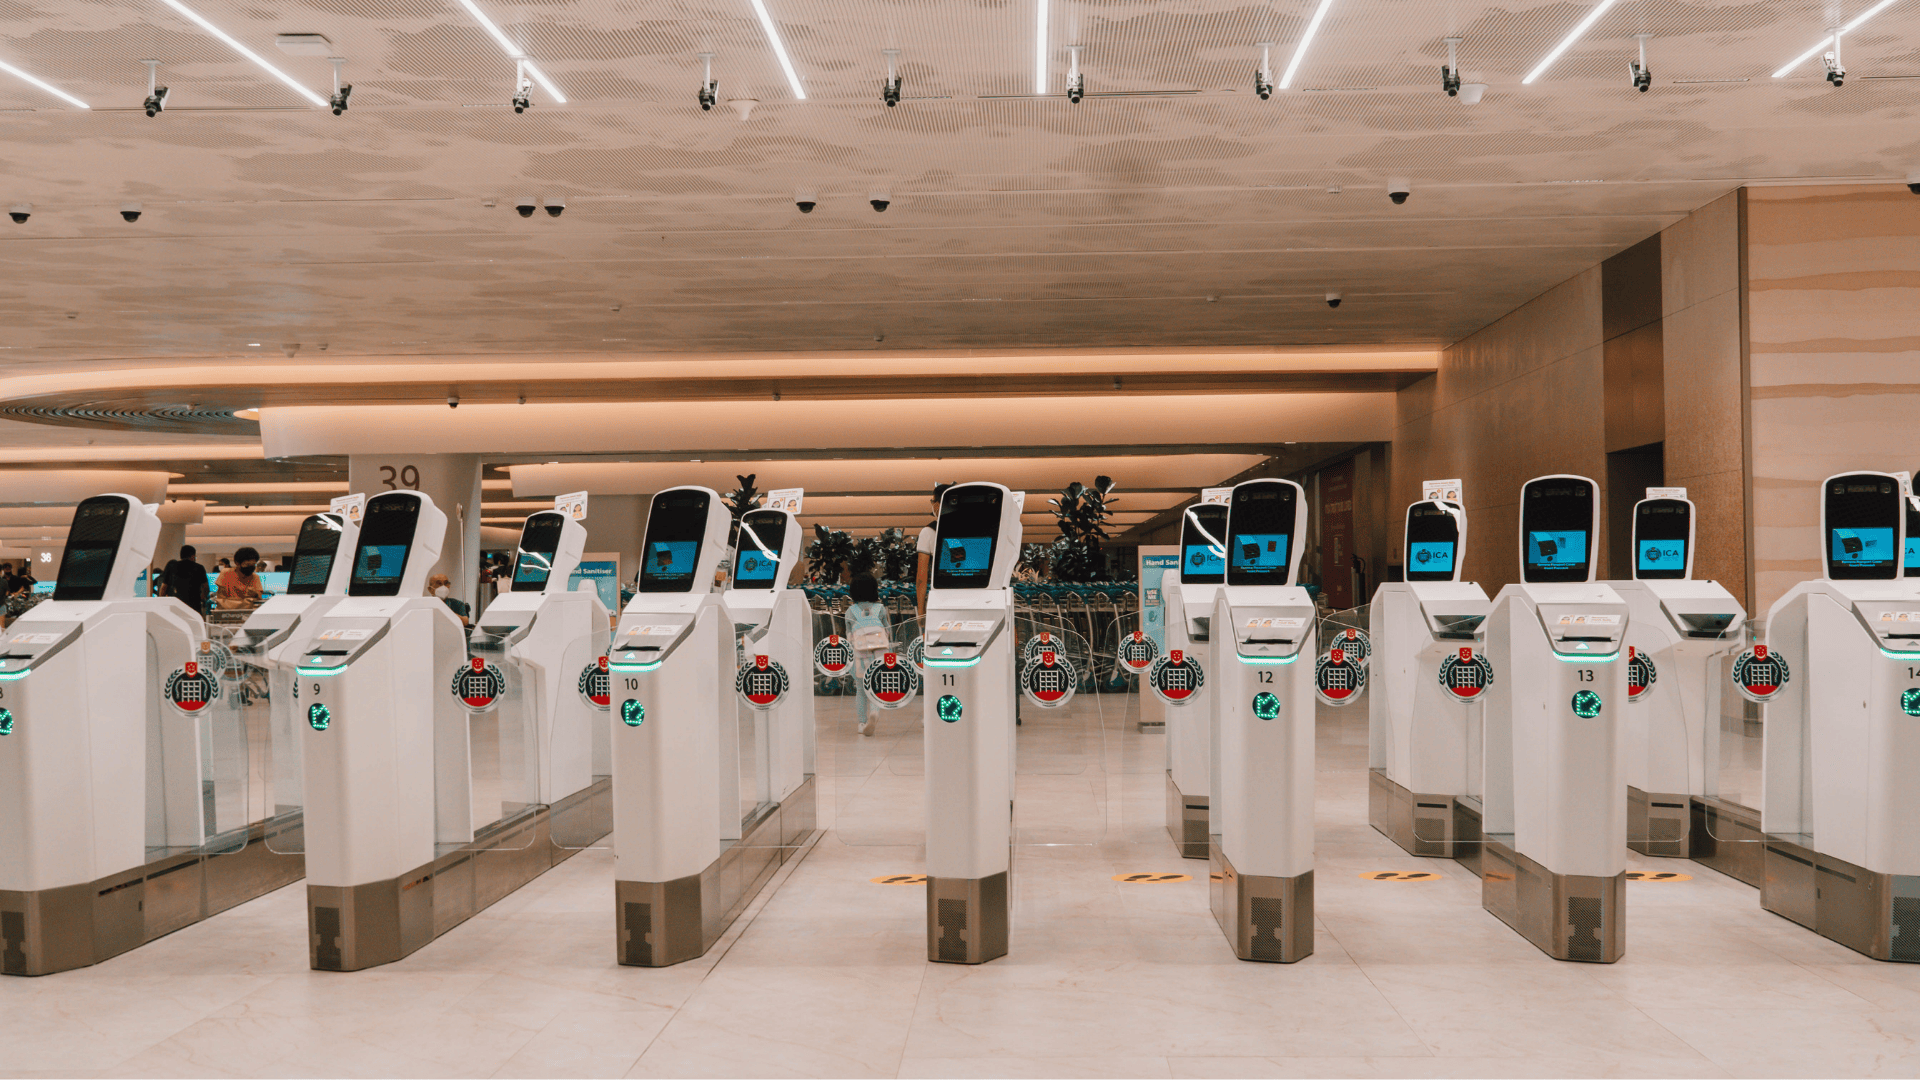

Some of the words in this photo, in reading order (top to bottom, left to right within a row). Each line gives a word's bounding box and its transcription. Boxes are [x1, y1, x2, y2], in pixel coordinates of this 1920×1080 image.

[379, 465, 419, 490] 39
[41, 552, 52, 563] 36
[1433, 551, 1448, 559] ICA
[1663, 549, 1679, 557] ICA
[942, 674, 954, 686] 11
[1258, 671, 1273, 683] 12
[1577, 669, 1594, 682] 13
[313, 683, 320, 695] 9
[625, 678, 638, 690] 10
